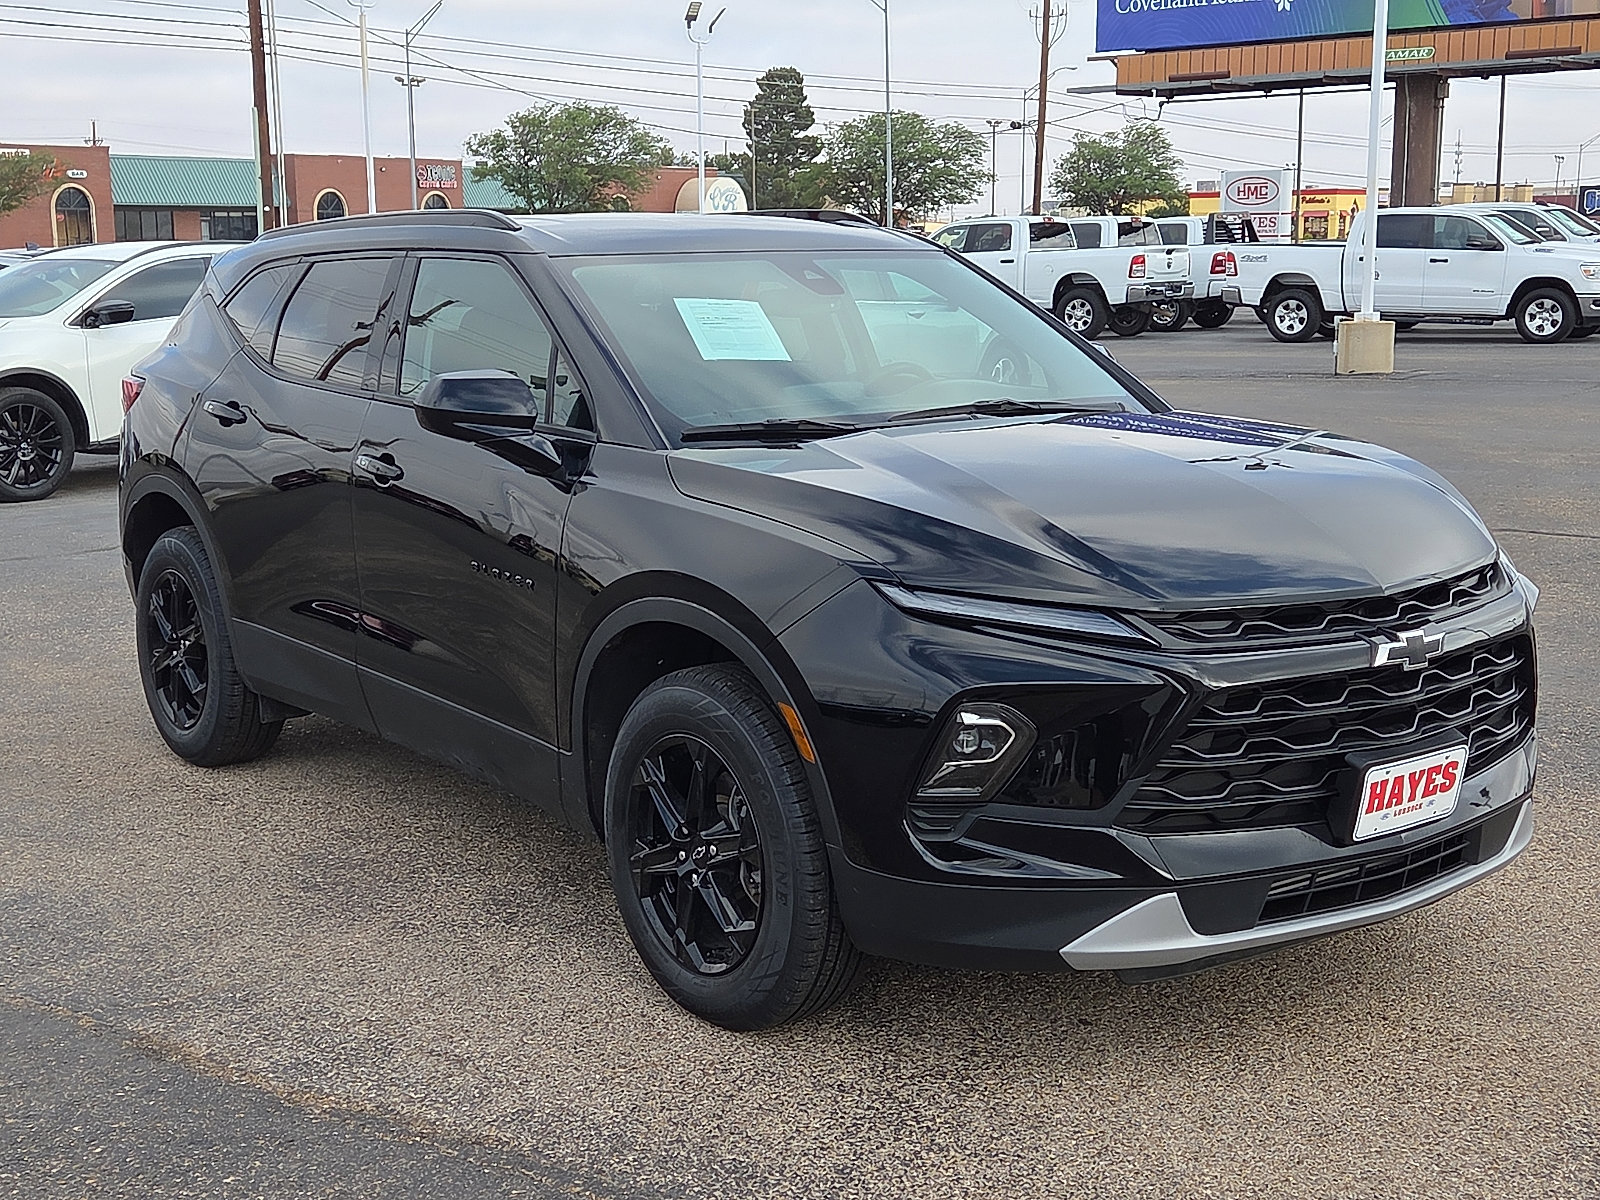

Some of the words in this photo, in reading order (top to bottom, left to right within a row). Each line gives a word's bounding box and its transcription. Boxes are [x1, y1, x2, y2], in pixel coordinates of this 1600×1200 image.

[1385, 49, 1429, 60] AMAR
[1236, 182, 1269, 200] HMC
[469, 560, 535, 593] BLAZER
[1364, 760, 1460, 816] HAYES
